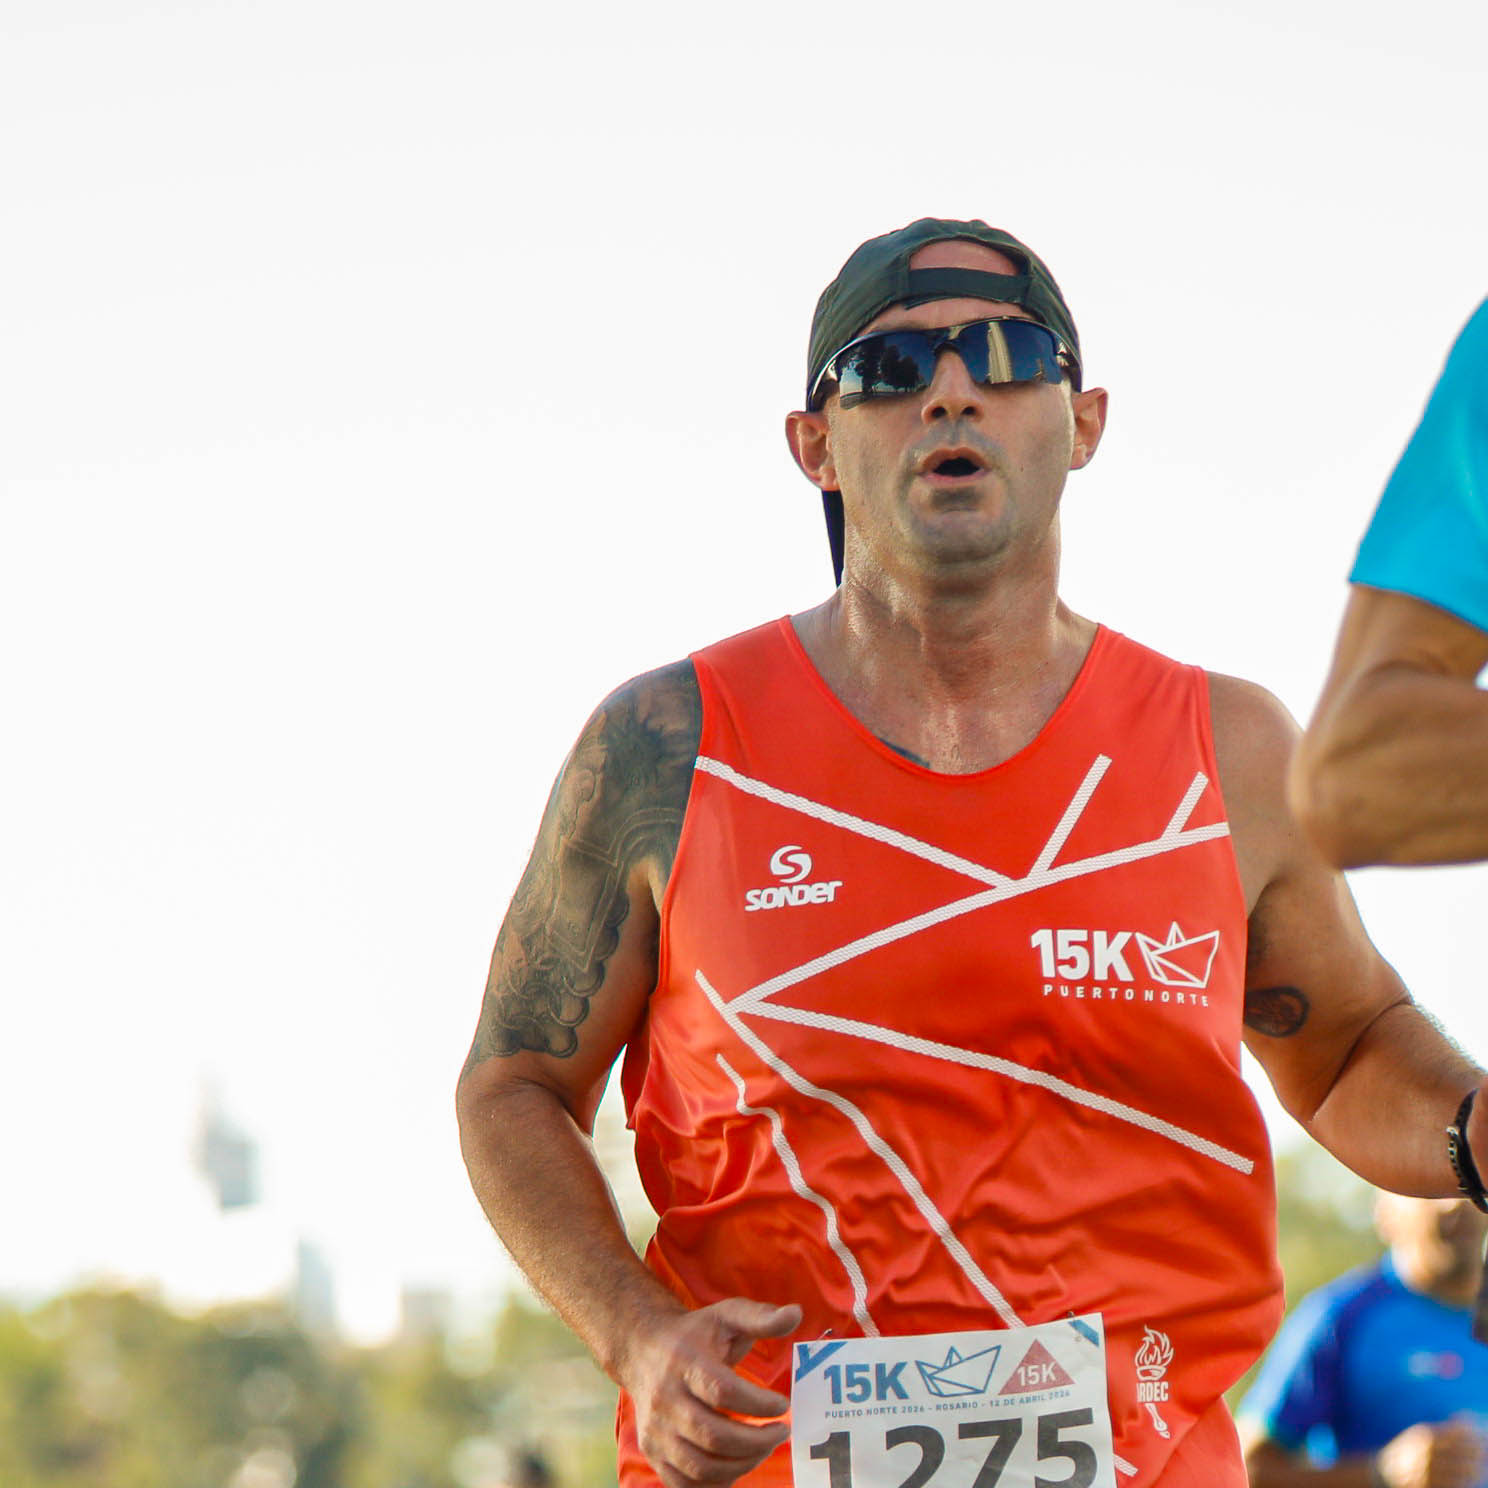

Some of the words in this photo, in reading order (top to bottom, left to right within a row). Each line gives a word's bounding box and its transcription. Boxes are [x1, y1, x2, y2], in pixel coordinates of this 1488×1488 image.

[1030, 929, 1135, 982] 15K
[823, 1361, 910, 1405] 15K
[1017, 1361, 1057, 1388] 15K
[824, 1409, 864, 1419] PUERTO
[866, 1406, 898, 1416] NORTE
[935, 1401, 978, 1411] ROSARIO
